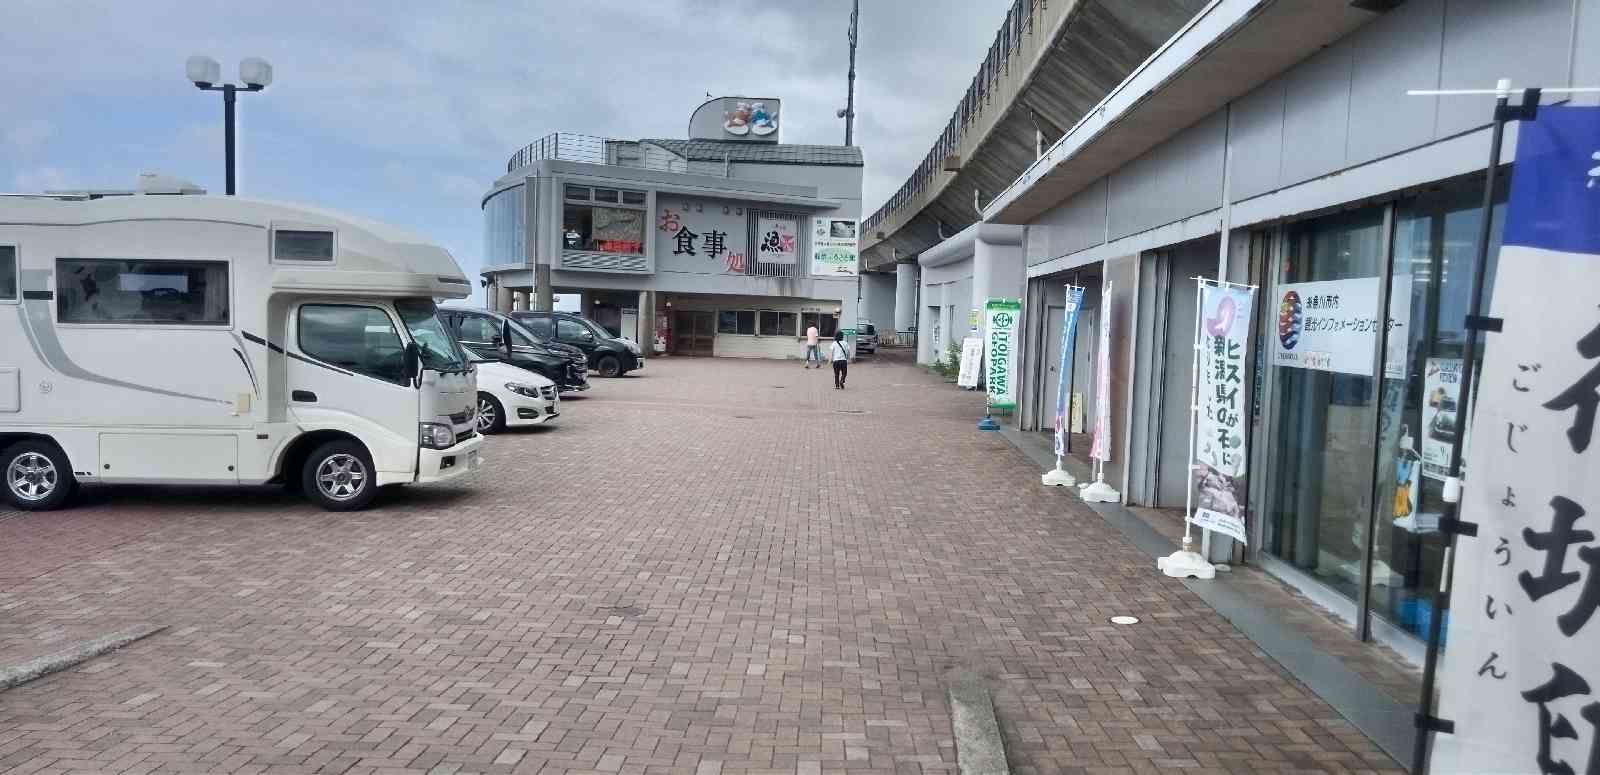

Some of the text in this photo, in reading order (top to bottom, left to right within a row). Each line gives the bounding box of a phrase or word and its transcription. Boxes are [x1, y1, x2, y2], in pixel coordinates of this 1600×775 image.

[656, 208, 745, 273] お食事処
[989, 331, 999, 394] GEOPARK
[996, 331, 1008, 396] ITOIGAWA
[1226, 338, 1241, 429] ヒスイが
[1477, 362, 1542, 680] ごじょういん
